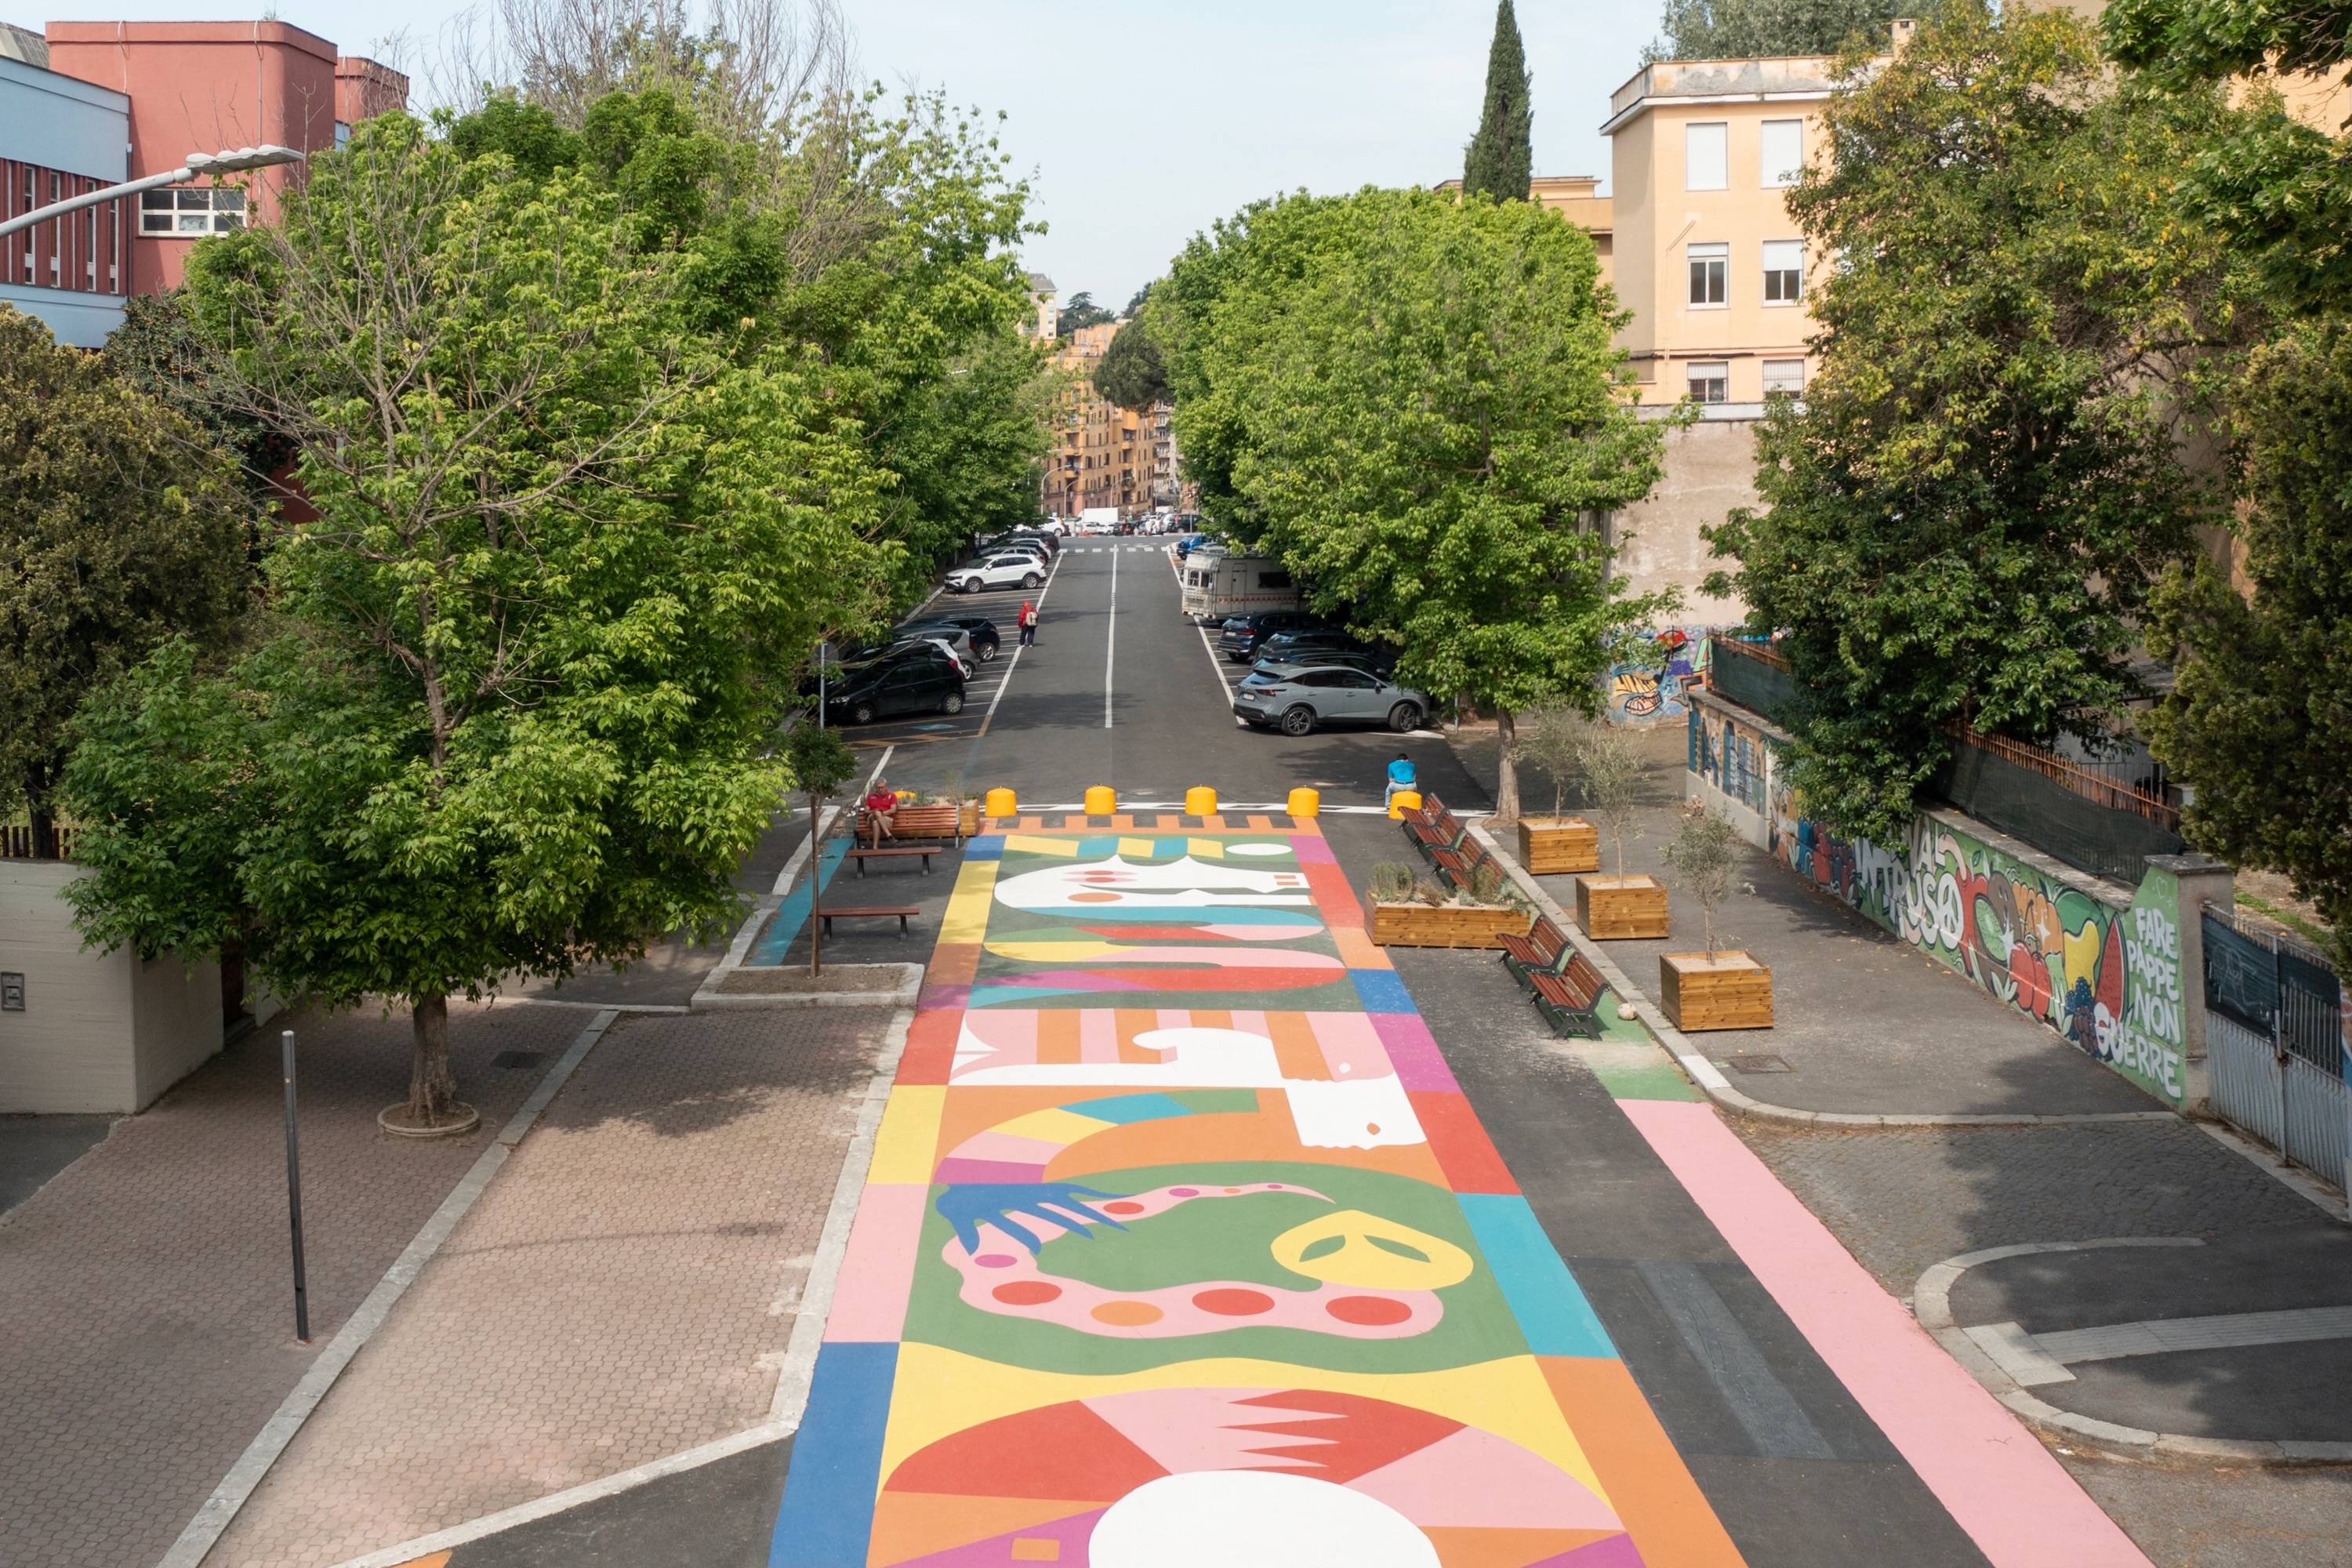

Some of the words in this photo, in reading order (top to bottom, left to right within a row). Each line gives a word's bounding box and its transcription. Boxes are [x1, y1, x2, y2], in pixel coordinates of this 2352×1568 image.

[2135, 907, 2178, 960] FARE
[2127, 940, 2179, 1001] PAPPE
[2133, 982, 2180, 1044] NON
[2093, 1002, 2181, 1098] GUERRE
